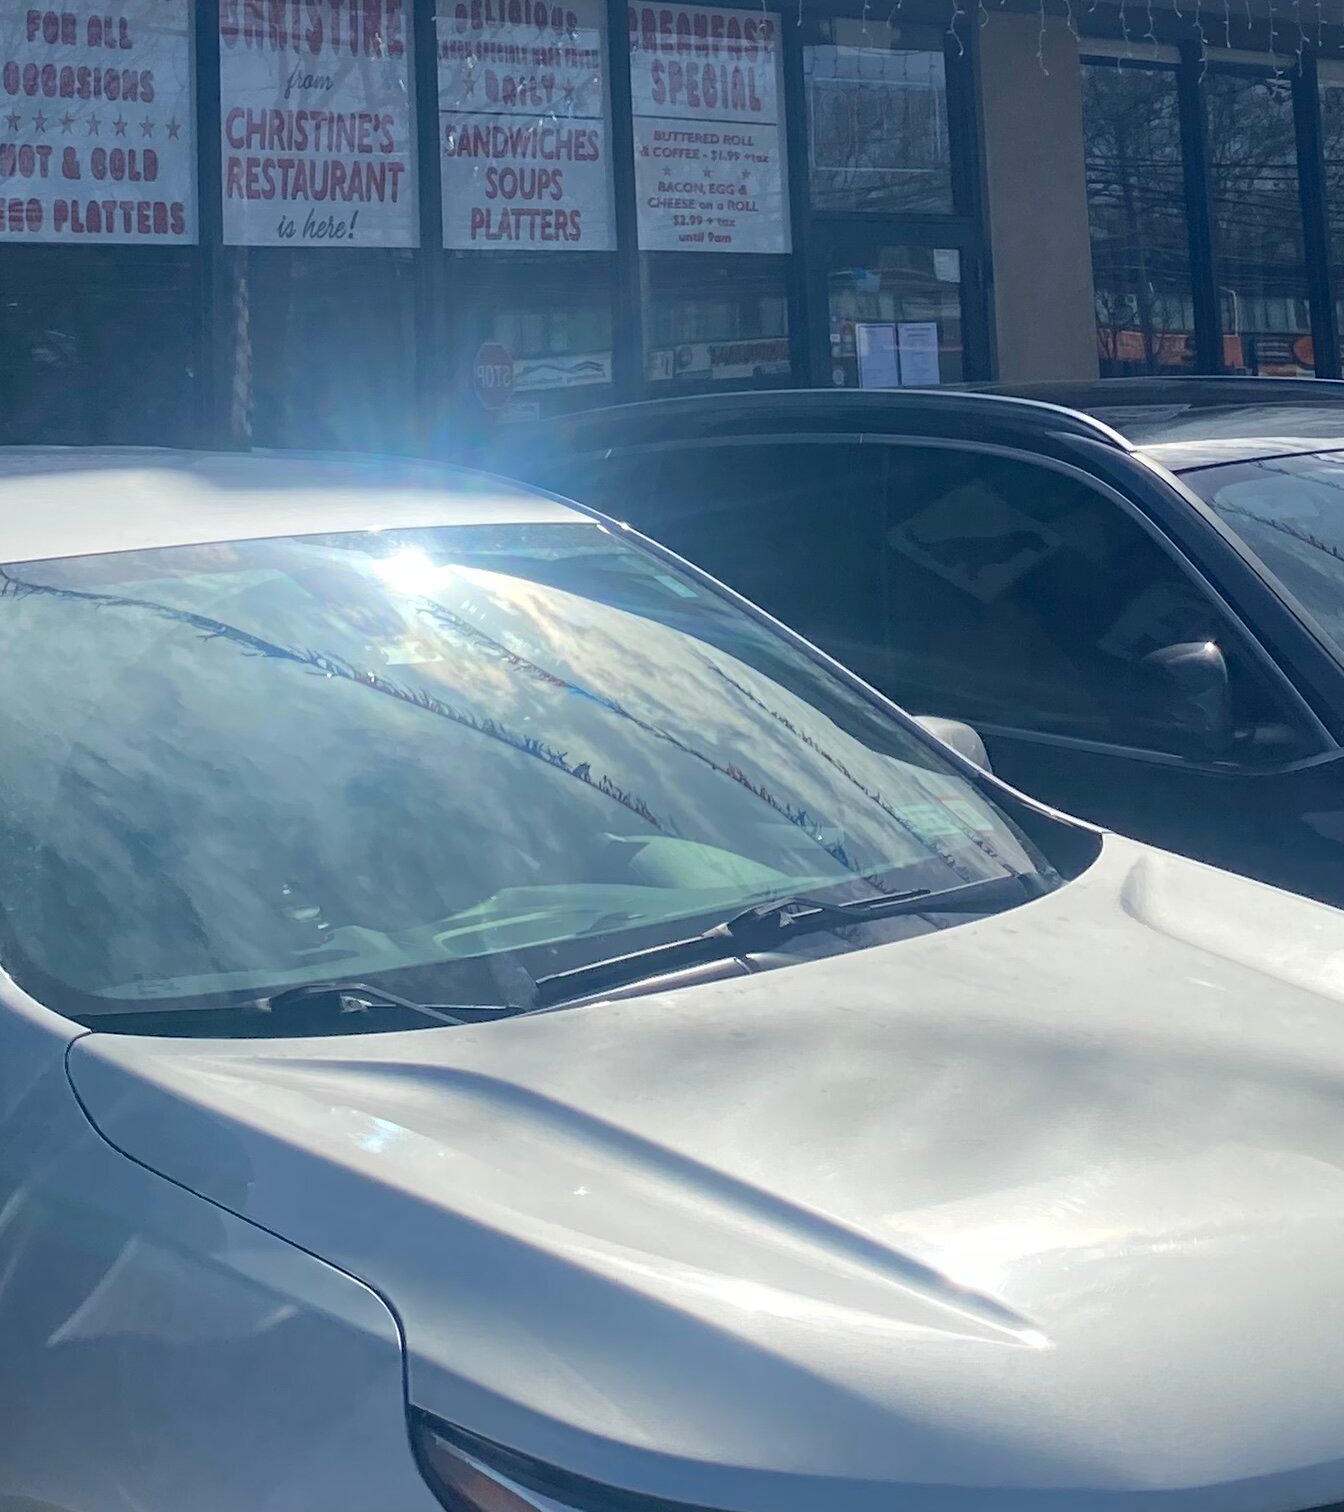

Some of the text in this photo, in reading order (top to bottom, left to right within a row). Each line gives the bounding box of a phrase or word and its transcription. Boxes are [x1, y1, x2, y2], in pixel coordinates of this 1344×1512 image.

[26, 9, 133, 50] FOR ALL
[3, 60, 155, 103] OCCASIONS
[284, 62, 334, 100] from
[650, 58, 762, 112] SPECIAL
[225, 106, 395, 154] CHRISTINE'S
[443, 123, 600, 162] SANDWICHES
[653, 130, 754, 147] BUTTERED ROLL
[0, 142, 159, 182] HOT & COLD
[652, 146, 701, 160] COFFEE
[227, 156, 405, 203] RESTAURANT
[485, 166, 564, 201] SOUPS
[708, 183, 736, 195] EGG
[53, 198, 185, 235] PLATTERS
[647, 196, 697, 209] CHEESE
[727, 199, 759, 212] ROLL
[277, 207, 359, 240] is here!
[470, 206, 582, 242] PLATTERS
